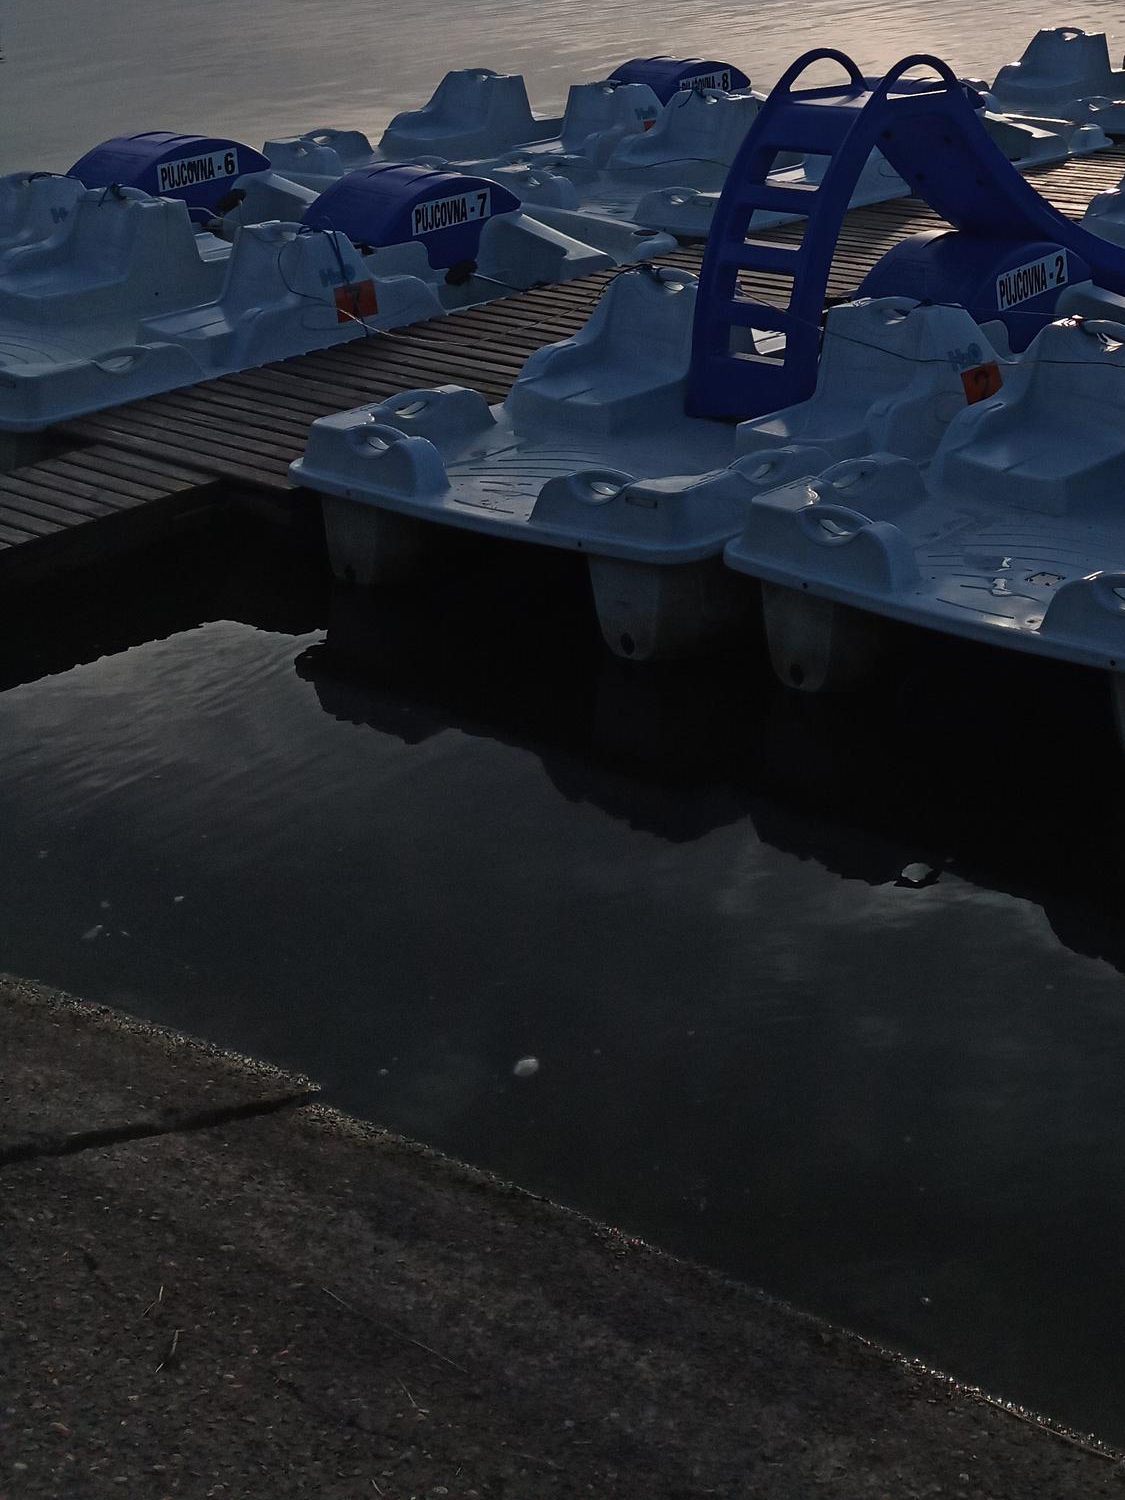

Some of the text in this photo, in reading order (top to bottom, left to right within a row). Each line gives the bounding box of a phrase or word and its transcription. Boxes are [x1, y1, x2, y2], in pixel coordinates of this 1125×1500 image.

[721, 73, 729, 90] 8
[224, 152, 235, 175] 6
[415, 197, 468, 233] PŮJČOVNA
[477, 192, 487, 217] 7
[1055, 255, 1065, 285] 2
